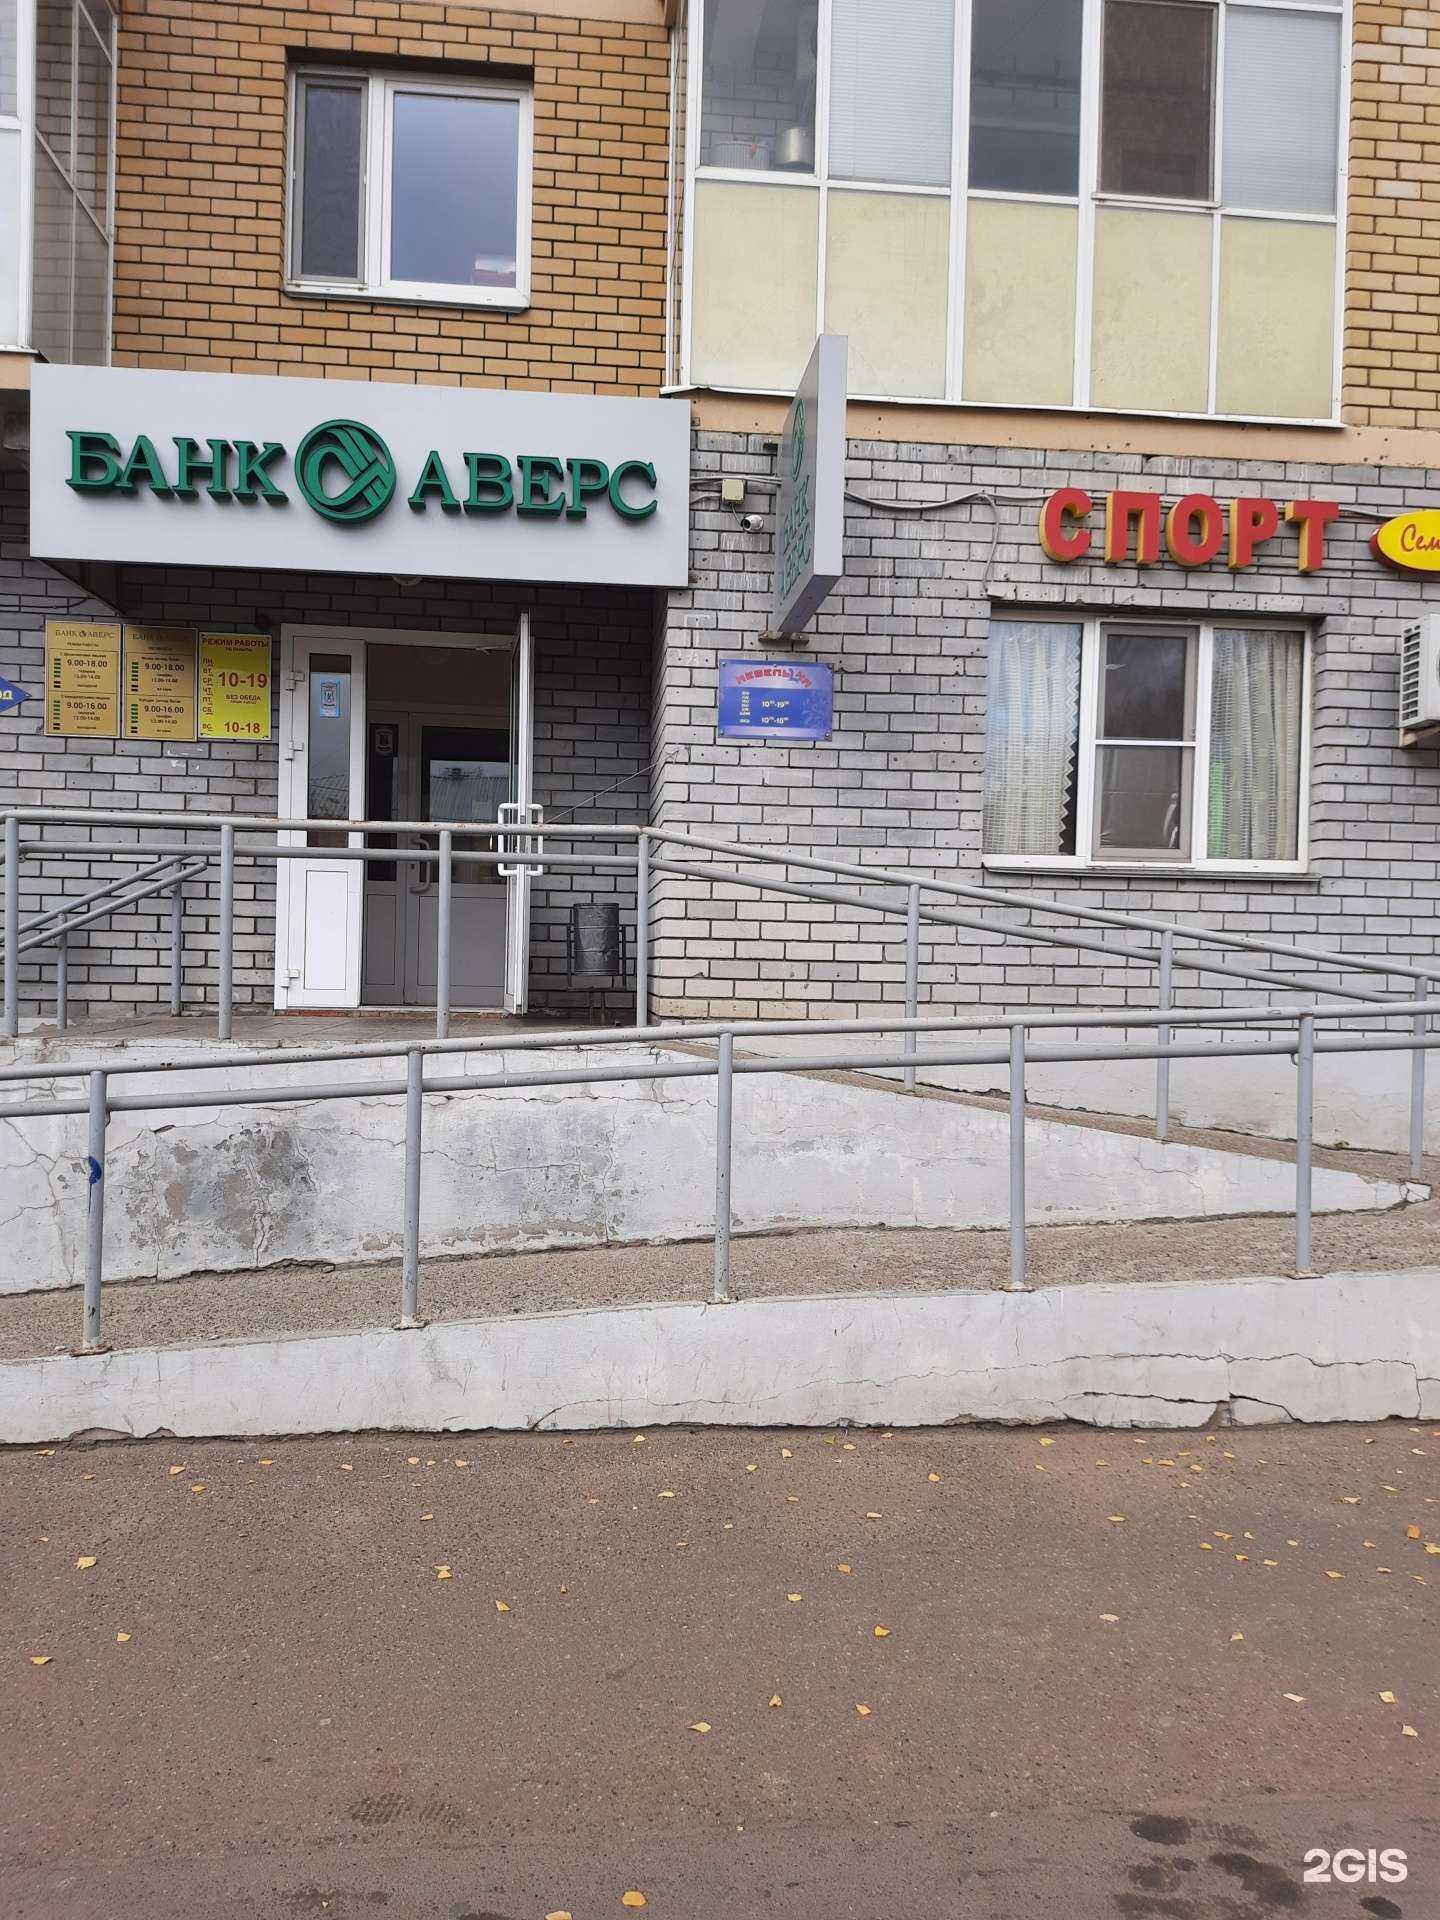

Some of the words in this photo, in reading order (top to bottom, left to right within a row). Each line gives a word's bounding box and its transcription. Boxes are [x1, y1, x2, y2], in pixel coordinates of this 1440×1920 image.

[65, 430, 288, 503] БАНК
[408, 450, 658, 521] АВЕРС
[1038, 487, 1340, 573] СПОРТ
[55, 629, 77, 637] БАНК
[88, 631, 115, 639] АВЕРС
[202, 638, 233, 646] РЕЖИМ
[235, 640, 269, 648] РАБОТЫ
[67, 659, 108, 668] 9.00-18.00
[145, 663, 185, 672] 9.00-18.00
[218, 672, 267, 688] 10-19
[67, 702, 107, 710] 9.00-16.00
[144, 705, 185, 714] 9.00-16.00
[224, 722, 260, 733] 10-18
